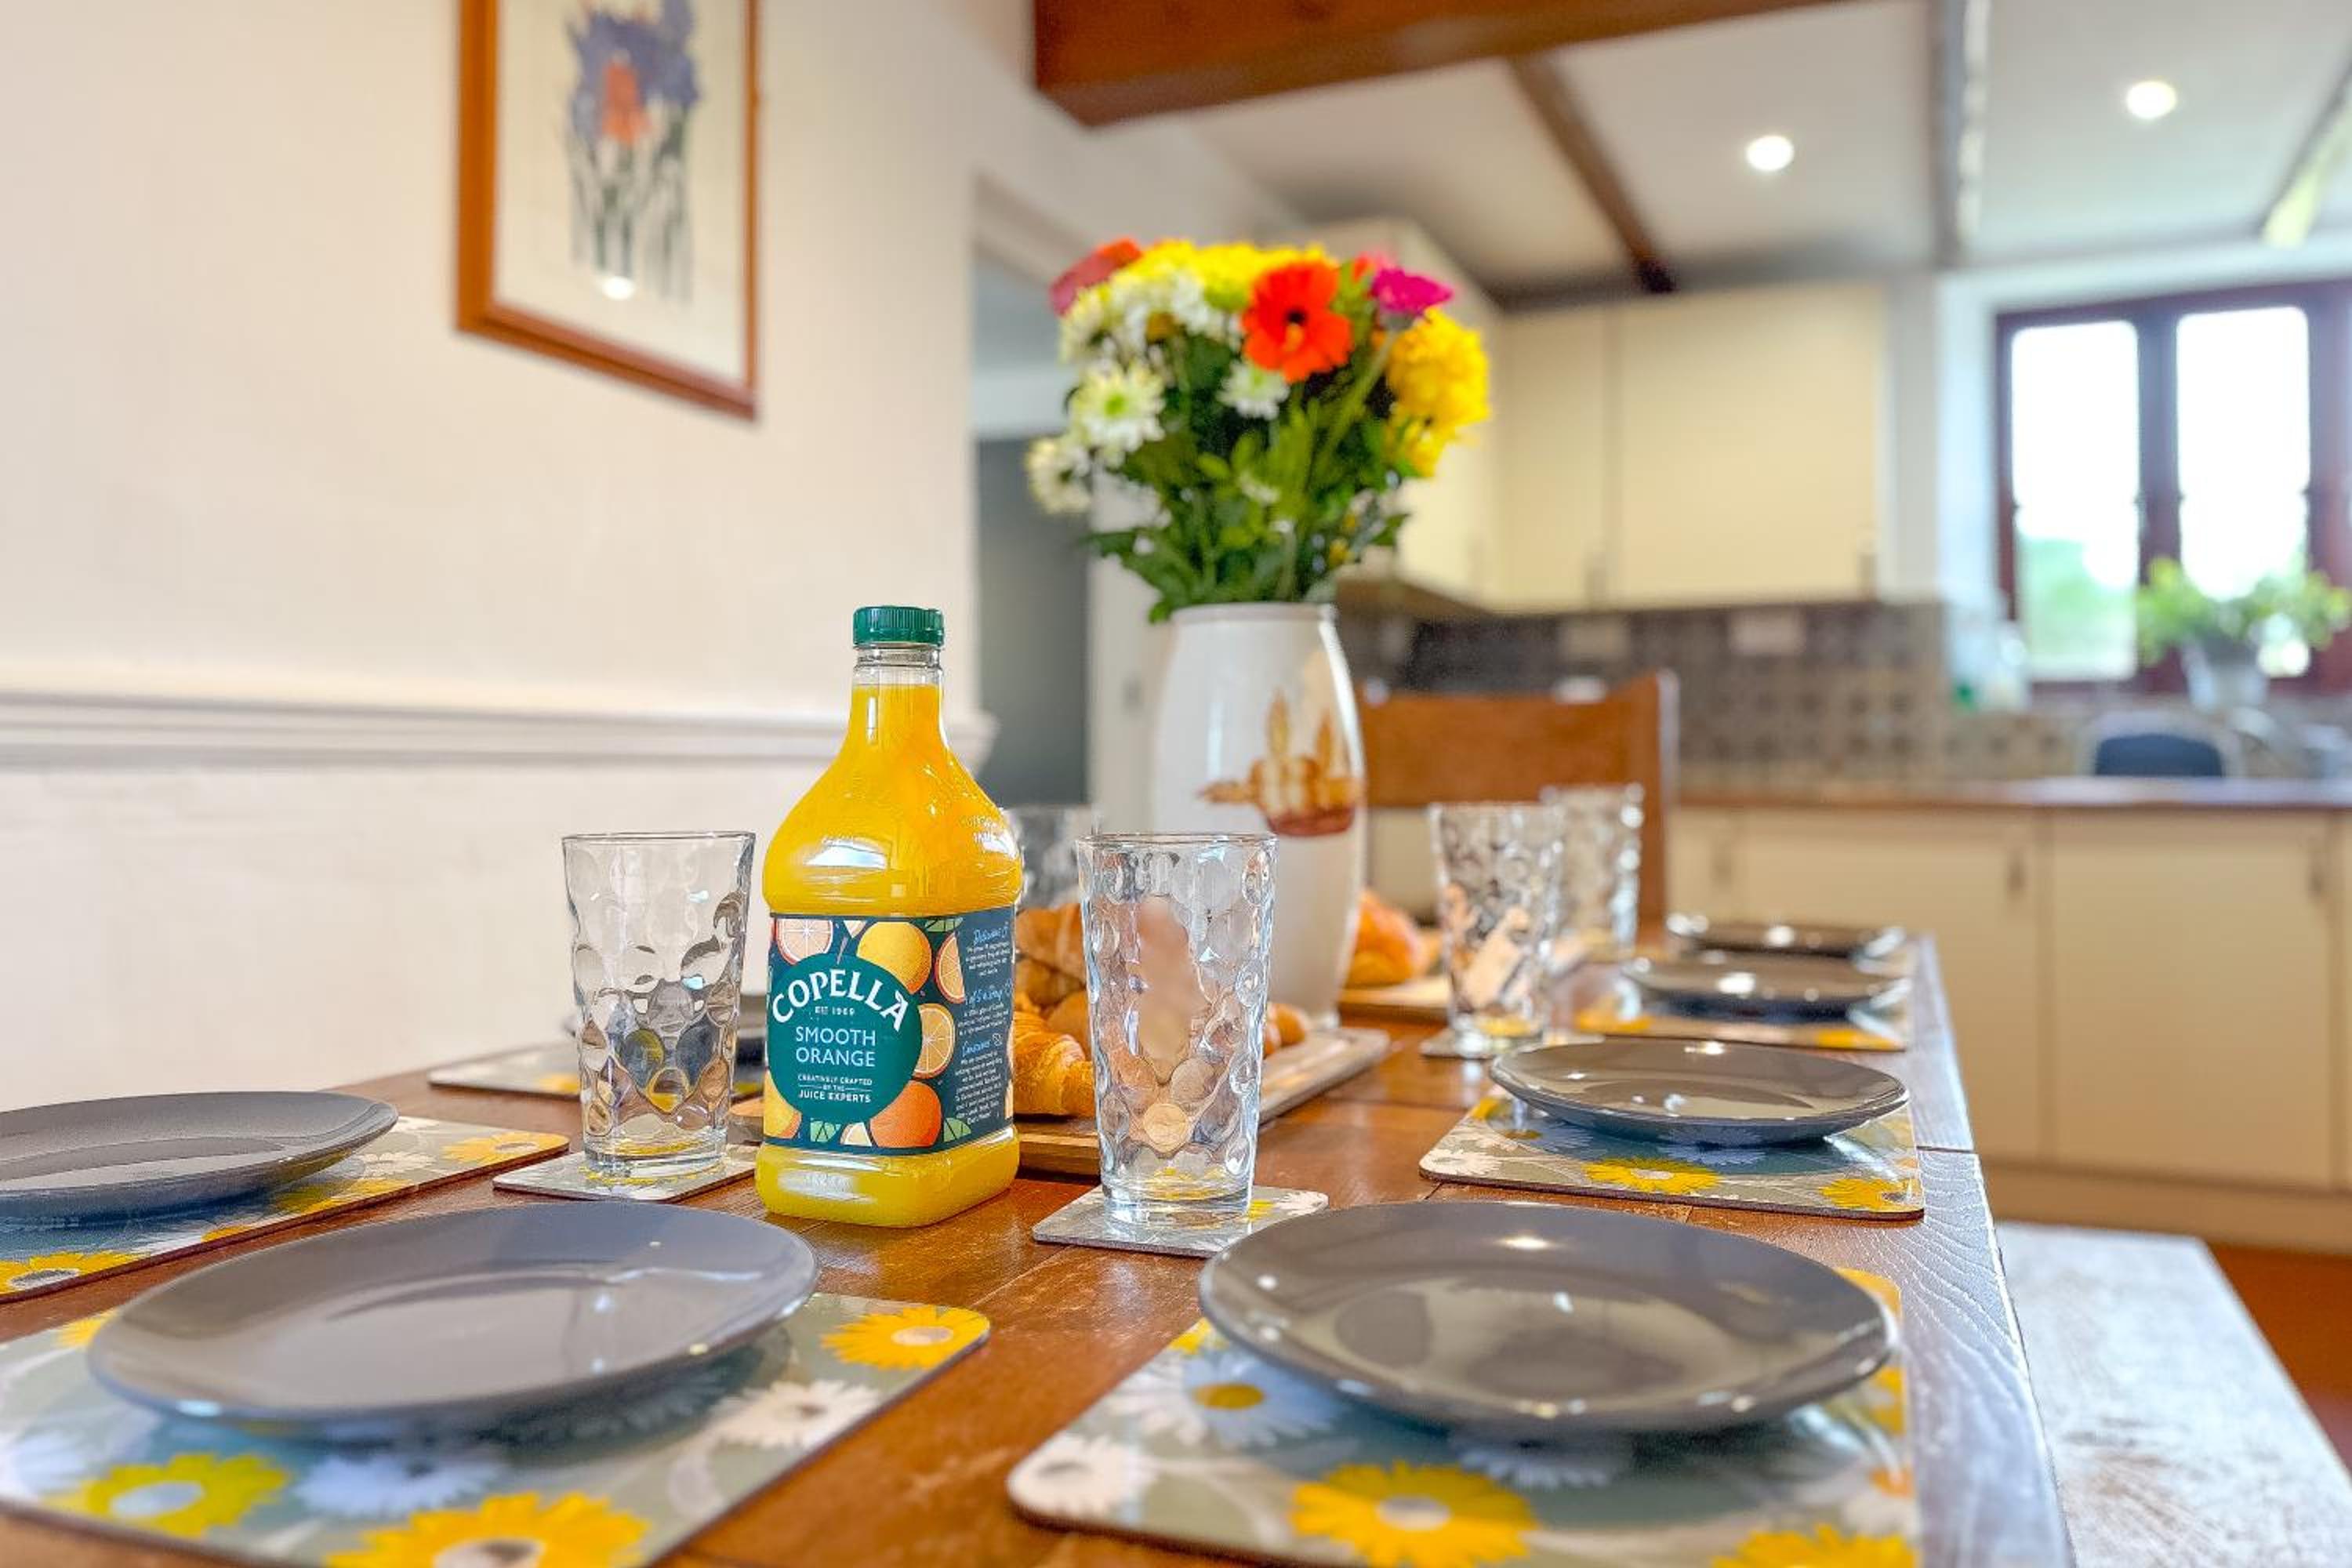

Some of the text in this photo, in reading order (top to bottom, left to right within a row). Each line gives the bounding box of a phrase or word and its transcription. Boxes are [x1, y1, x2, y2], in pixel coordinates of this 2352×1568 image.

[772, 968, 909, 1032] COPELLA
[796, 1025, 876, 1047] SMOOTH
[796, 1047, 876, 1067] ORANGE
[840, 1076, 873, 1086] CRAFTED
[798, 1089, 872, 1104] JUICE EXPERTS
